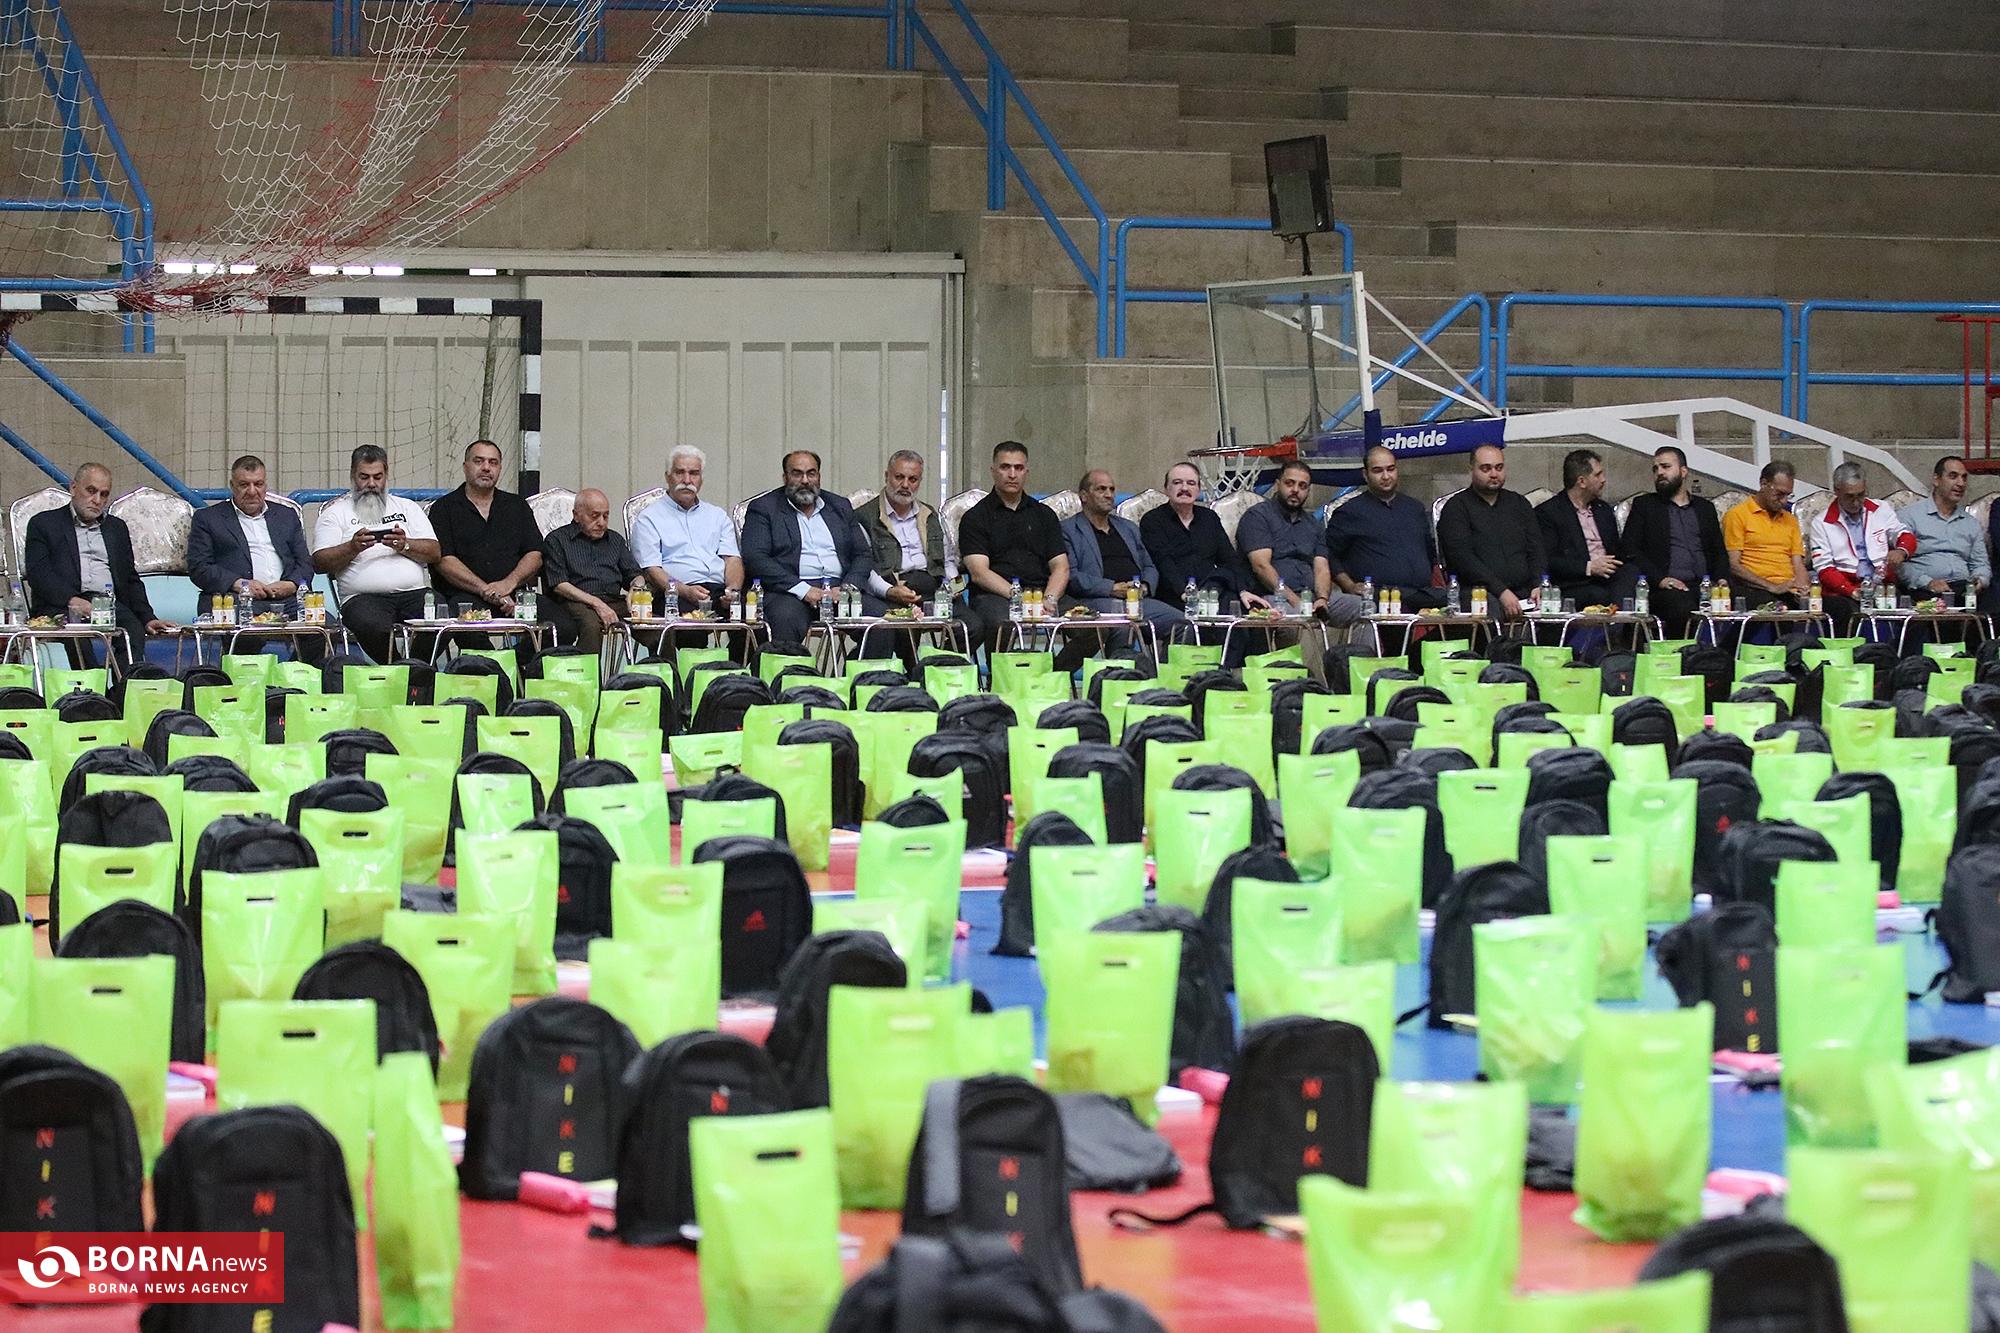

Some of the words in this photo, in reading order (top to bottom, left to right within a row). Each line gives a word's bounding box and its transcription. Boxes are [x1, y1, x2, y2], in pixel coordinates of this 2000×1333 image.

[1381, 430, 1447, 451] chelde
[558, 1055, 577, 1174] NIKE
[1301, 1076, 1324, 1167] NIK
